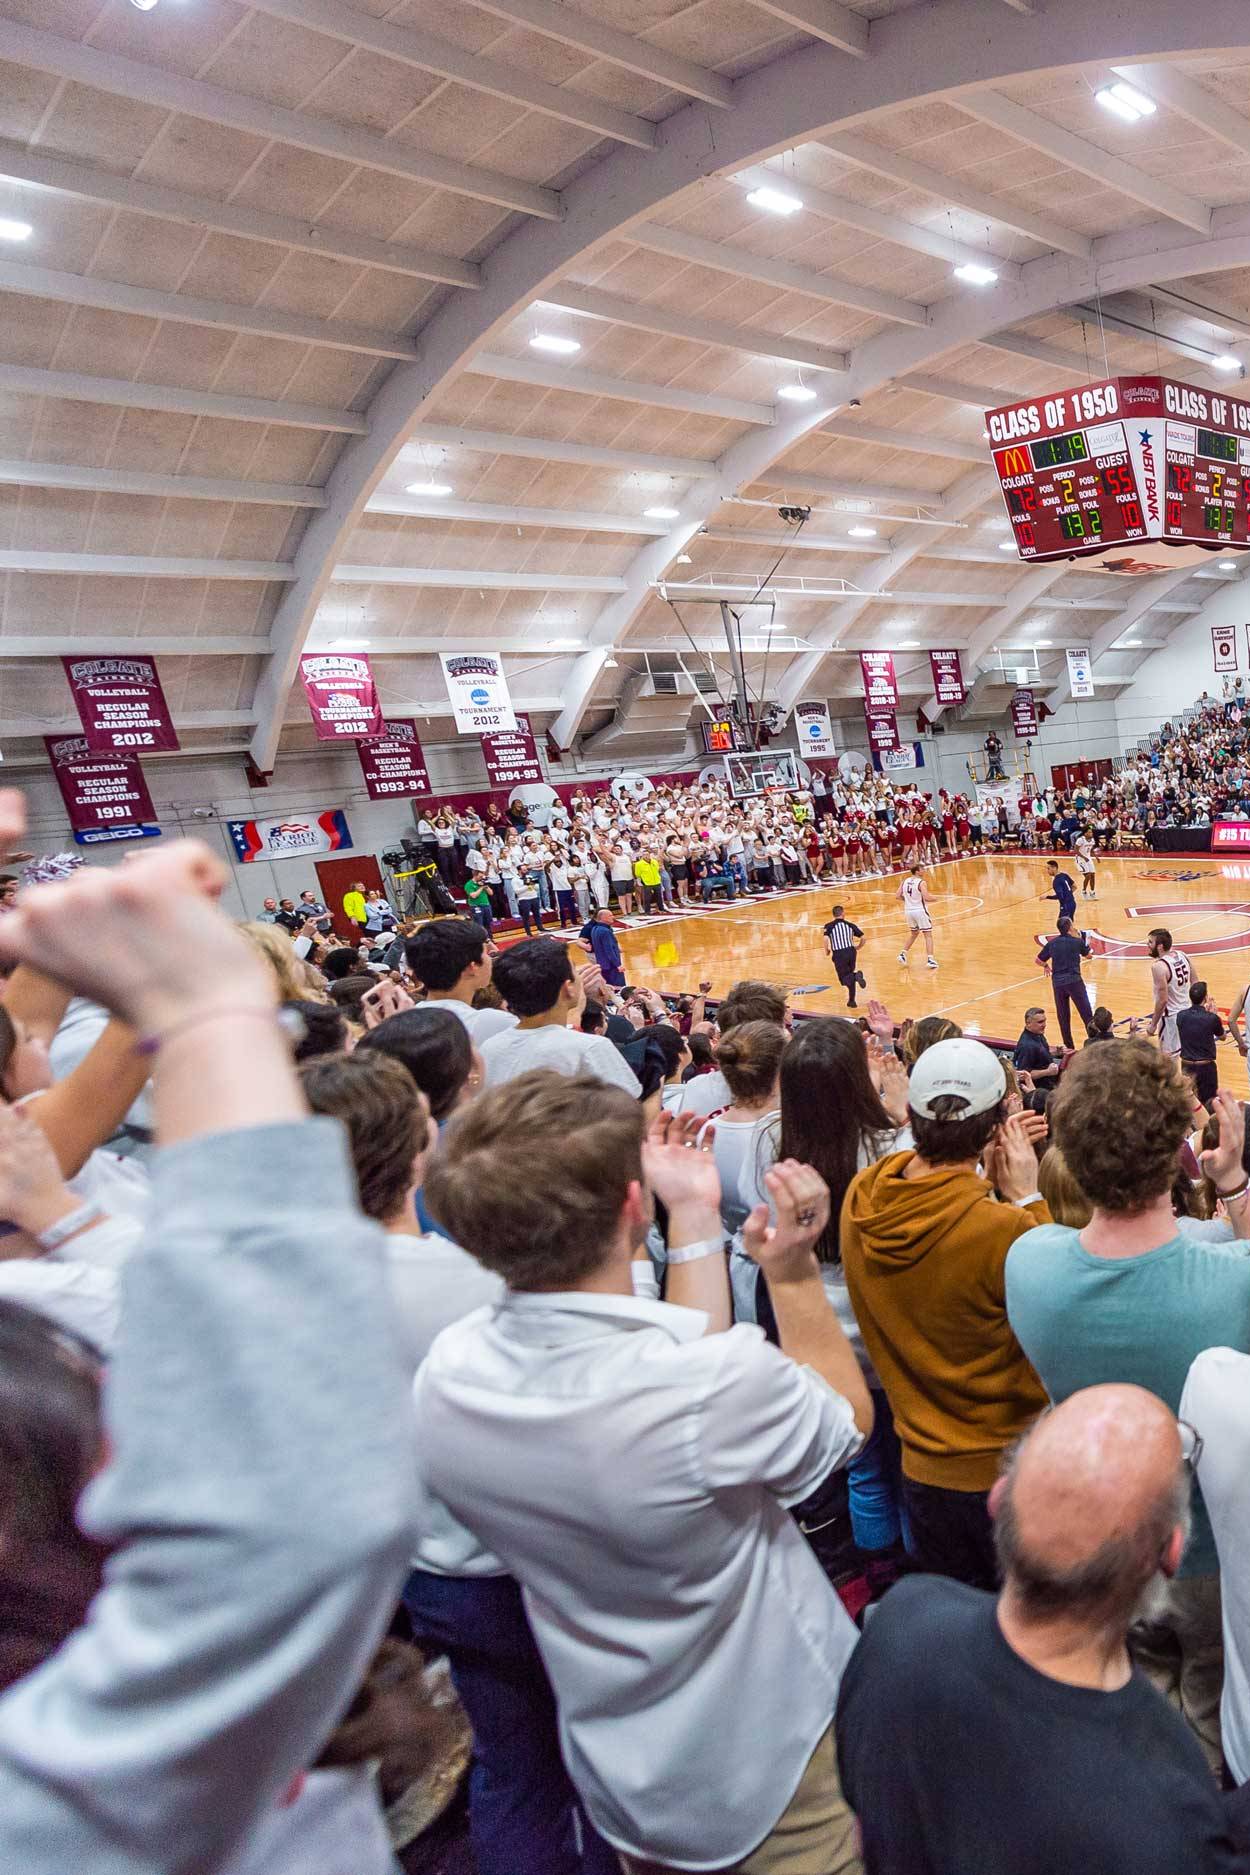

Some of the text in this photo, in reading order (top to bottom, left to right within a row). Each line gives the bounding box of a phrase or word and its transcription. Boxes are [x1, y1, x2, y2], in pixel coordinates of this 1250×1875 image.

[1164, 384, 1208, 421] CLASS
[1211, 397, 1227, 426] OF
[989, 385, 1119, 442] CLASS OF 1950
[1049, 434, 1086, 463] 1:19
[1095, 453, 1129, 470] GUEST
[1166, 451, 1195, 467] COLGATE
[1208, 464, 1226, 475] PERIOD
[1001, 473, 1035, 490] COLGATE
[1052, 470, 1076, 482] PERIOD
[1079, 475, 1095, 486] POSS
[1105, 466, 1133, 495] 55
[1140, 442, 1160, 522] NBT BANK
[1173, 466, 1192, 493] 72
[1195, 471, 1207, 481] POSS
[1039, 484, 1055, 494] POSS
[1062, 479, 1074, 503] 2
[1195, 484, 1210, 494] BONUS
[1213, 474, 1222, 497] 2
[1013, 487, 1036, 511] 72
[1078, 488, 1098, 499] BONUS
[1116, 492, 1138, 503] FOULS
[1166, 491, 1183, 501] FOULS
[1043, 496, 1060, 507] BONUS
[1204, 497, 1236, 509] PLAYER FOUL
[1055, 501, 1100, 515] PLAYER FOUL
[1168, 501, 1181, 526] 10
[1011, 513, 1031, 523] FOULS
[1121, 503, 1142, 528] 10
[1209, 508, 1233, 532] 13 2
[1066, 510, 1102, 536] 13 2
[1016, 523, 1035, 545] 10
[1125, 527, 1143, 537] WON
[1169, 527, 1183, 536] WON
[1083, 535, 1102, 545] GAME
[1021, 546, 1037, 556] WON
[932, 652, 957, 660] COLGATE
[70, 659, 155, 681] COLGATE
[87, 688, 149, 697] VOLLEYBALL
[96, 702, 150, 712] REGULAR
[458, 706, 507, 715] TOURNAMENT
[103, 711, 149, 720] SEASON
[472, 715, 501, 726] 2012
[94, 719, 162, 729] CHAMPIONS
[334, 721, 369, 734] 2012
[111, 732, 155, 746] 2012
[370, 747, 411, 755] BASKETBALL
[809, 745, 826, 753] 1995
[374, 756, 412, 765] REGULAR
[487, 759, 539, 769] CO-CHAMPIONS
[68, 763, 128, 774] VOLLEYBALL
[379, 764, 411, 772] SEASON
[366, 769, 427, 780] CO-CHAMPIONS
[494, 769, 539, 782] 1994-95
[76, 777, 128, 788] REGULAR
[375, 780, 426, 793] 1993-94
[83, 785, 127, 795] SEASON
[75, 792, 140, 804] CHAMPIONS
[95, 805, 132, 819] 1991
[82, 828, 144, 843] GEICO
[268, 831, 317, 842] PATRIOT
[1219, 828, 1238, 841] #15
[269, 837, 318, 849] LEAGUE
[906, 885, 912, 897] 4
[1064, 879, 1071, 892] 1
[1174, 964, 1189, 987] 55
